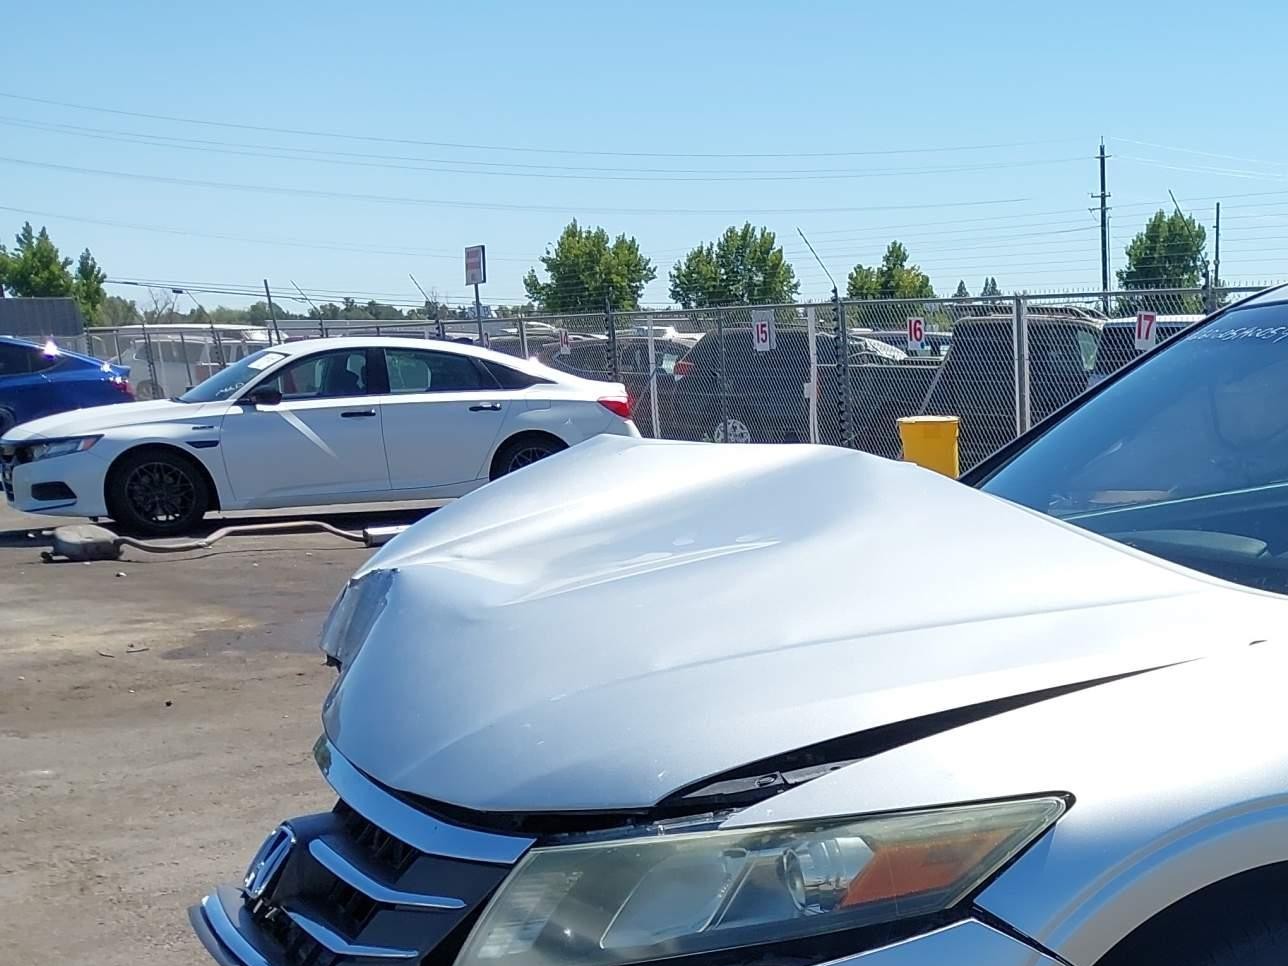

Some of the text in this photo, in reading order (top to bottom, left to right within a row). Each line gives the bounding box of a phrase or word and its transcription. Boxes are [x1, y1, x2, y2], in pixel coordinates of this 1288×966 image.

[756, 322, 768, 344] 15
[908, 319, 923, 342] 16
[1137, 313, 1155, 340] 17
